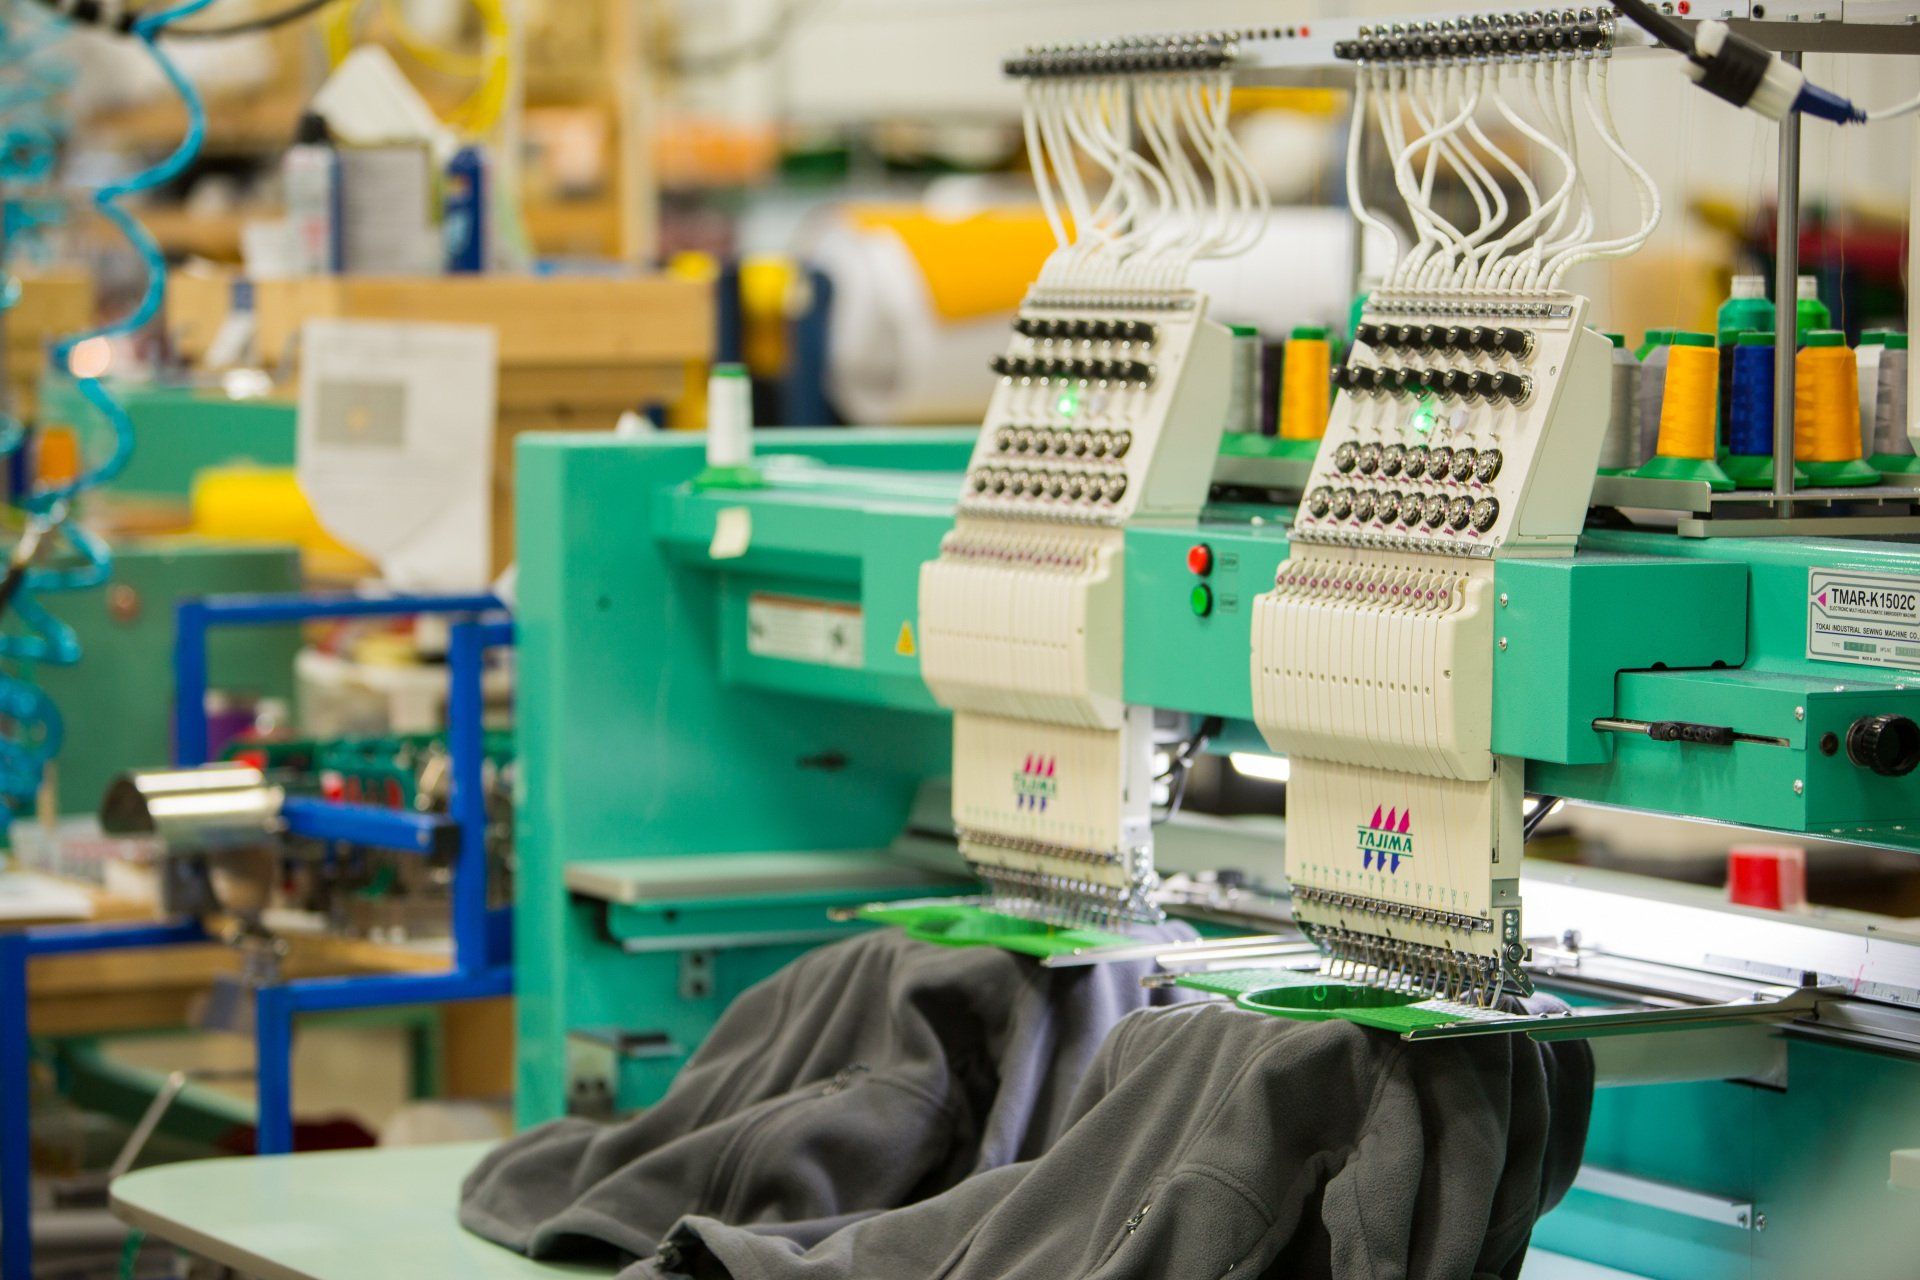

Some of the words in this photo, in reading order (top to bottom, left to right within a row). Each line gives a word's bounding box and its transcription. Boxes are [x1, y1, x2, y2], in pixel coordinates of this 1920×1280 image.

[1832, 589, 1915, 610] TMAR-K1502C
[1816, 623, 1830, 631] TOKAI
[1833, 624, 1861, 633] INDUSTRIAL
[1862, 627, 1883, 636] SEWING
[1885, 630, 1907, 638] MACHINE
[1358, 830, 1412, 852] TAJIMA
